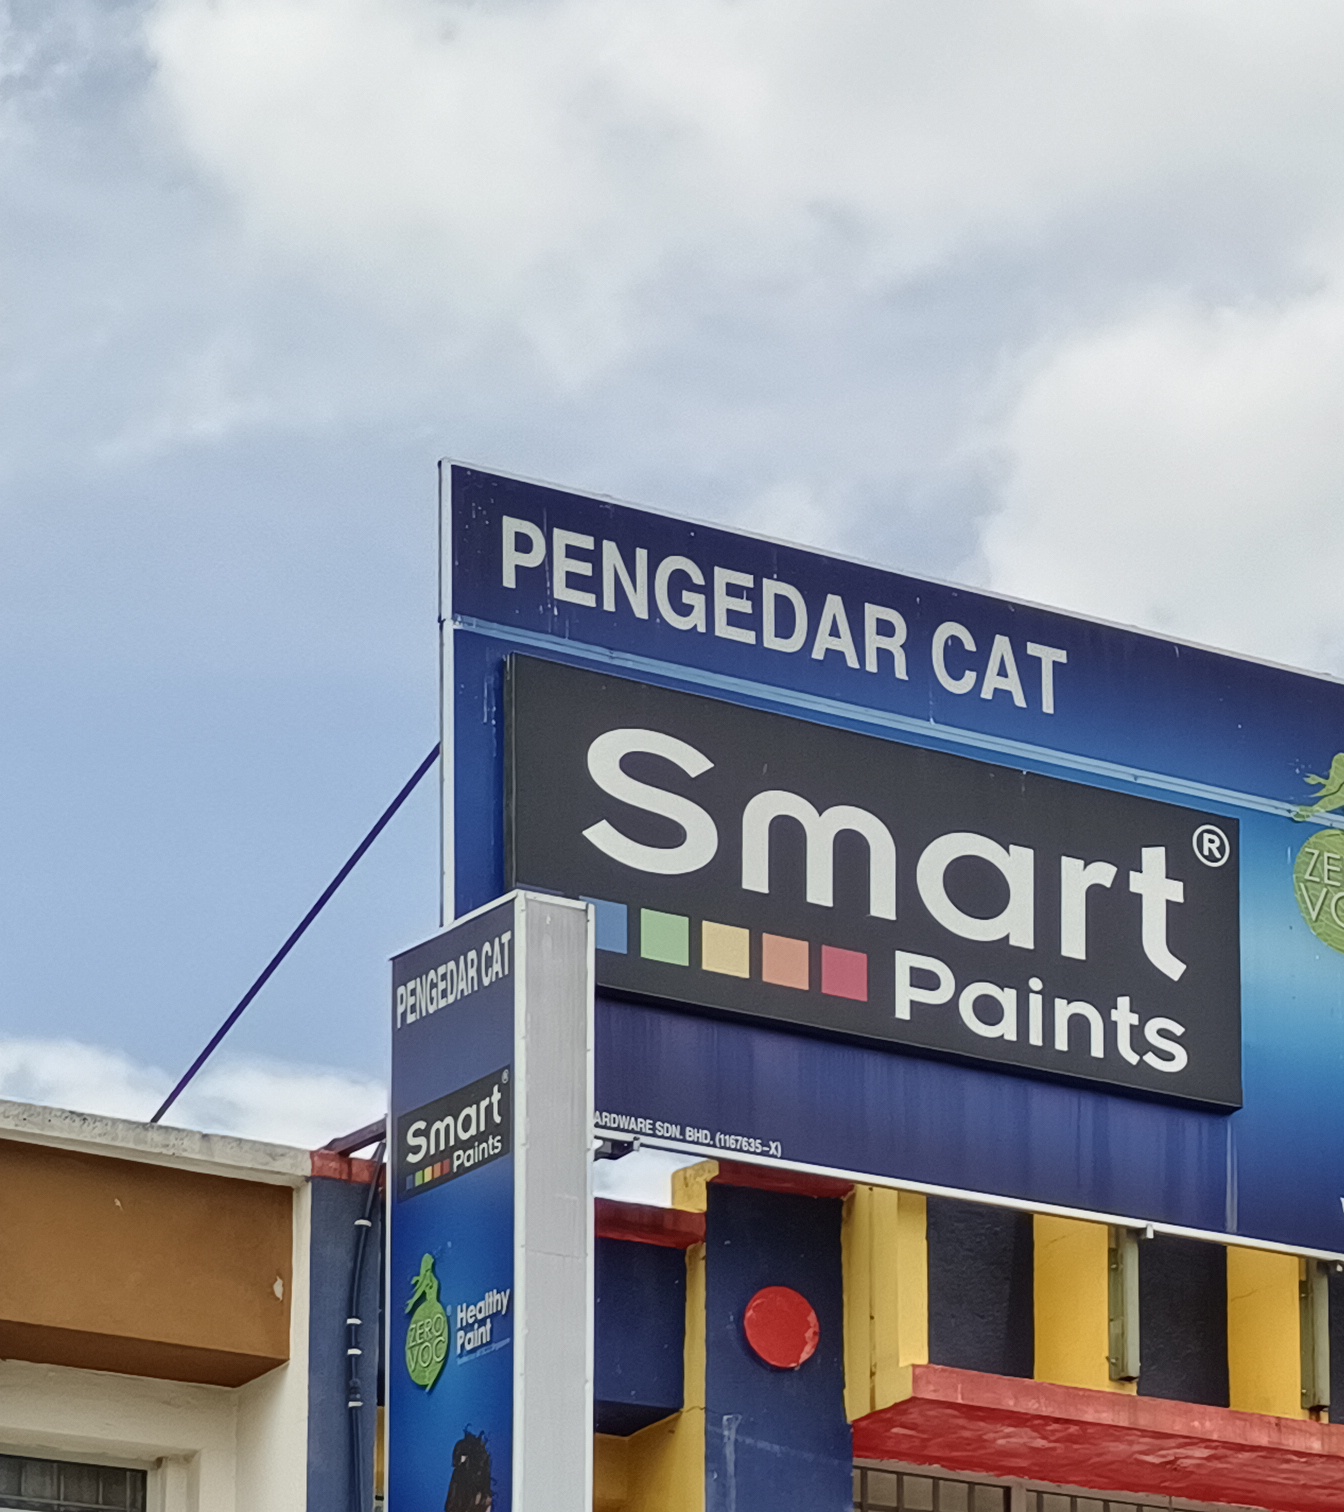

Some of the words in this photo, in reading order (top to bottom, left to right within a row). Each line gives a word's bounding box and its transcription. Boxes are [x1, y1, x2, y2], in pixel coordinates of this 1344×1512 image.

[501, 515, 907, 680] PENGEDAR
[931, 621, 1067, 714] CAT
[582, 728, 1187, 983] Smart
[397, 950, 478, 1028] PENGEDAR
[481, 931, 511, 980] CAT
[894, 950, 1189, 1074] Paints
[406, 1084, 502, 1163] Smart
[655, 1122, 683, 1139] SDN.
[685, 1126, 714, 1144] BHD.
[453, 1135, 502, 1173] Paints
[457, 1289, 510, 1327] Healthy
[408, 1314, 444, 1343] ZERO
[457, 1318, 491, 1355] Paint
[408, 1337, 445, 1373] VOC
